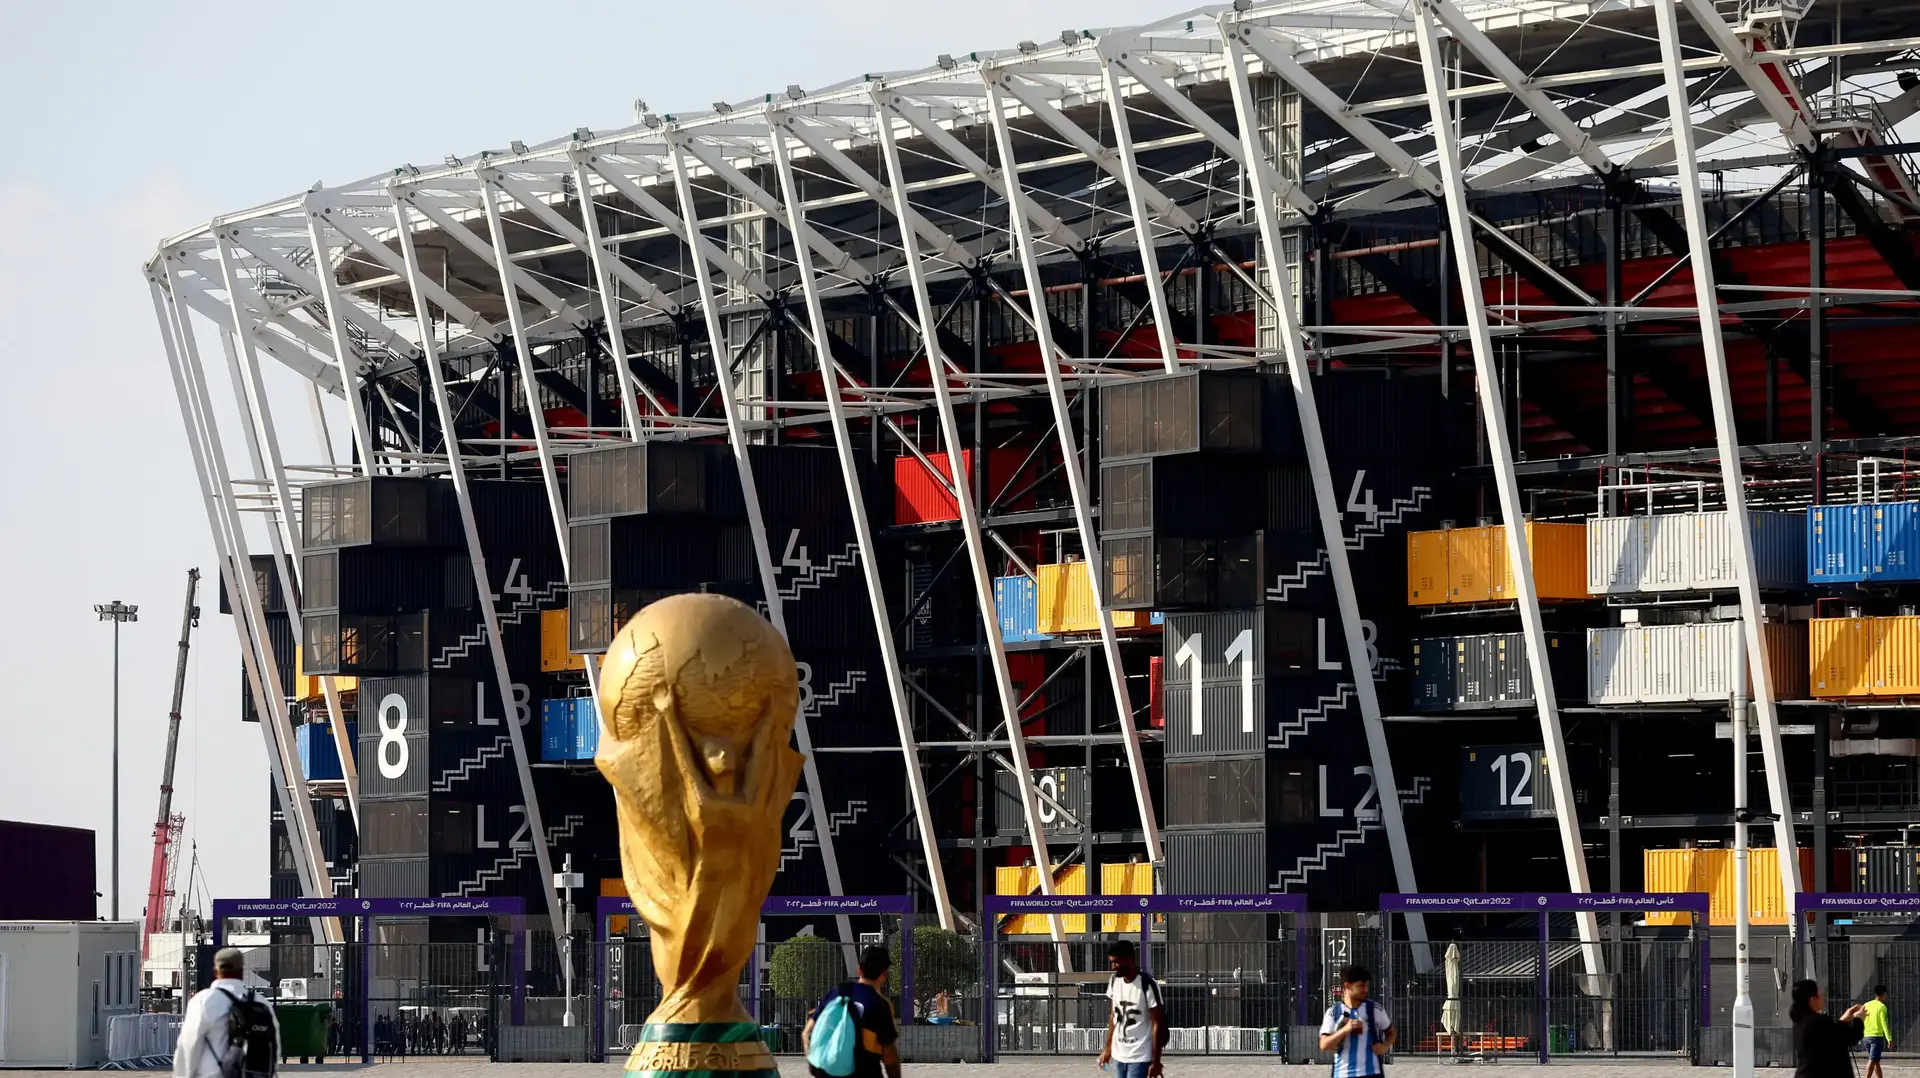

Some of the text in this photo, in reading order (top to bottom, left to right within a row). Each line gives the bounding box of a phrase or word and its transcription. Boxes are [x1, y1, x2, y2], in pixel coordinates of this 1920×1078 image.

[1337, 470, 1378, 521] 4
[771, 529, 812, 575] 4
[482, 558, 532, 601] 4
[1174, 629, 1253, 736] 11
[378, 693, 409, 779] 8
[1490, 752, 1533, 805] 12
[1319, 764, 1380, 818] L2
[477, 804, 533, 849] L2
[472, 901, 489, 909] كأس
[840, 900, 859, 908] العالم
[860, 899, 877, 908] كأس
[1234, 898, 1253, 907] العالم
[1254, 897, 1272, 907] كأس
[1635, 897, 1655, 905] العالم
[1656, 896, 1674, 905] كأس
[609, 947, 621, 963] 10
[1328, 939, 1347, 957] 12
[335, 951, 341, 966] 9
[654, 1042, 722, 1056] FIFA
[638, 1055, 741, 1071] WORLD CUP
